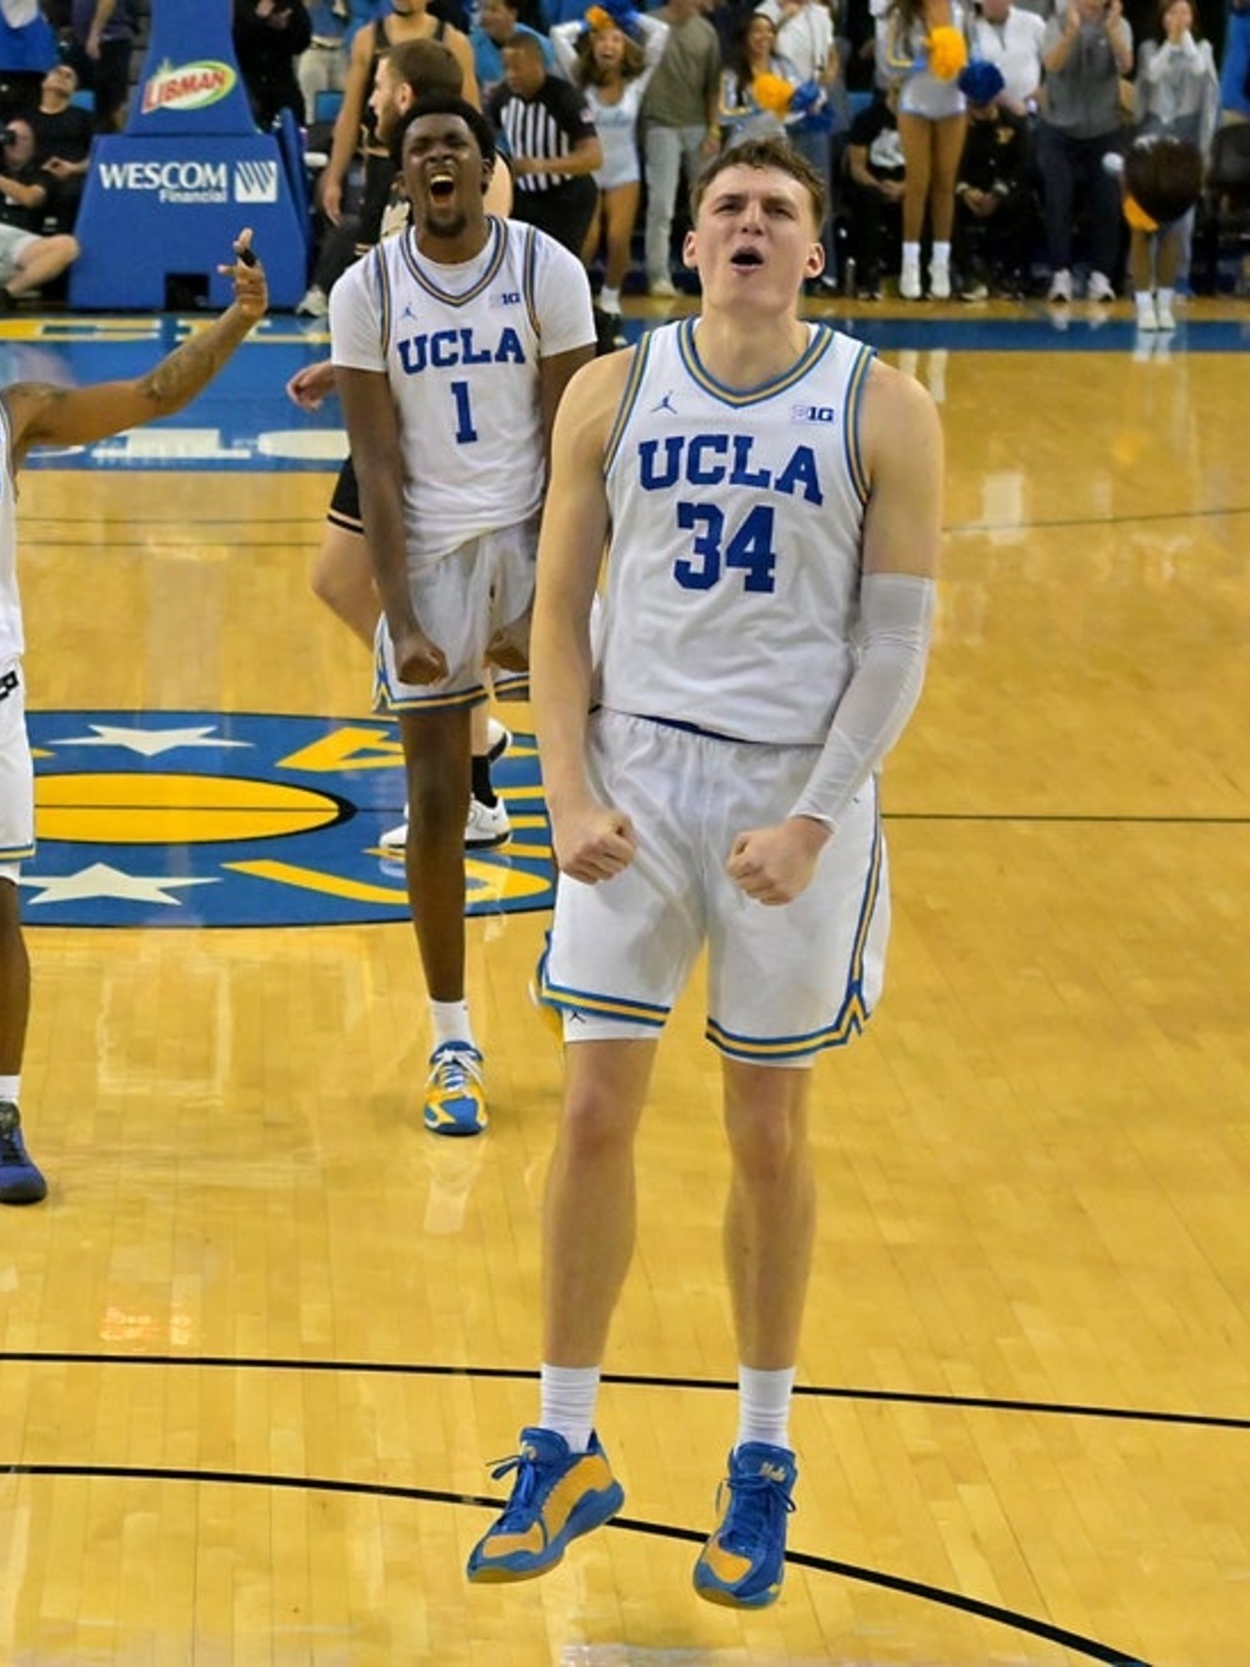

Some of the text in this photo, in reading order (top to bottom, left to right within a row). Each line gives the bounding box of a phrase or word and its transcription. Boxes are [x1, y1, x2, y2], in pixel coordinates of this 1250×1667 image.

[99, 161, 226, 189] WESCOM
[397, 327, 526, 375] UCLA
[451, 381, 478, 444] 1
[638, 433, 824, 507] UCLA
[674, 501, 776, 594] 34
